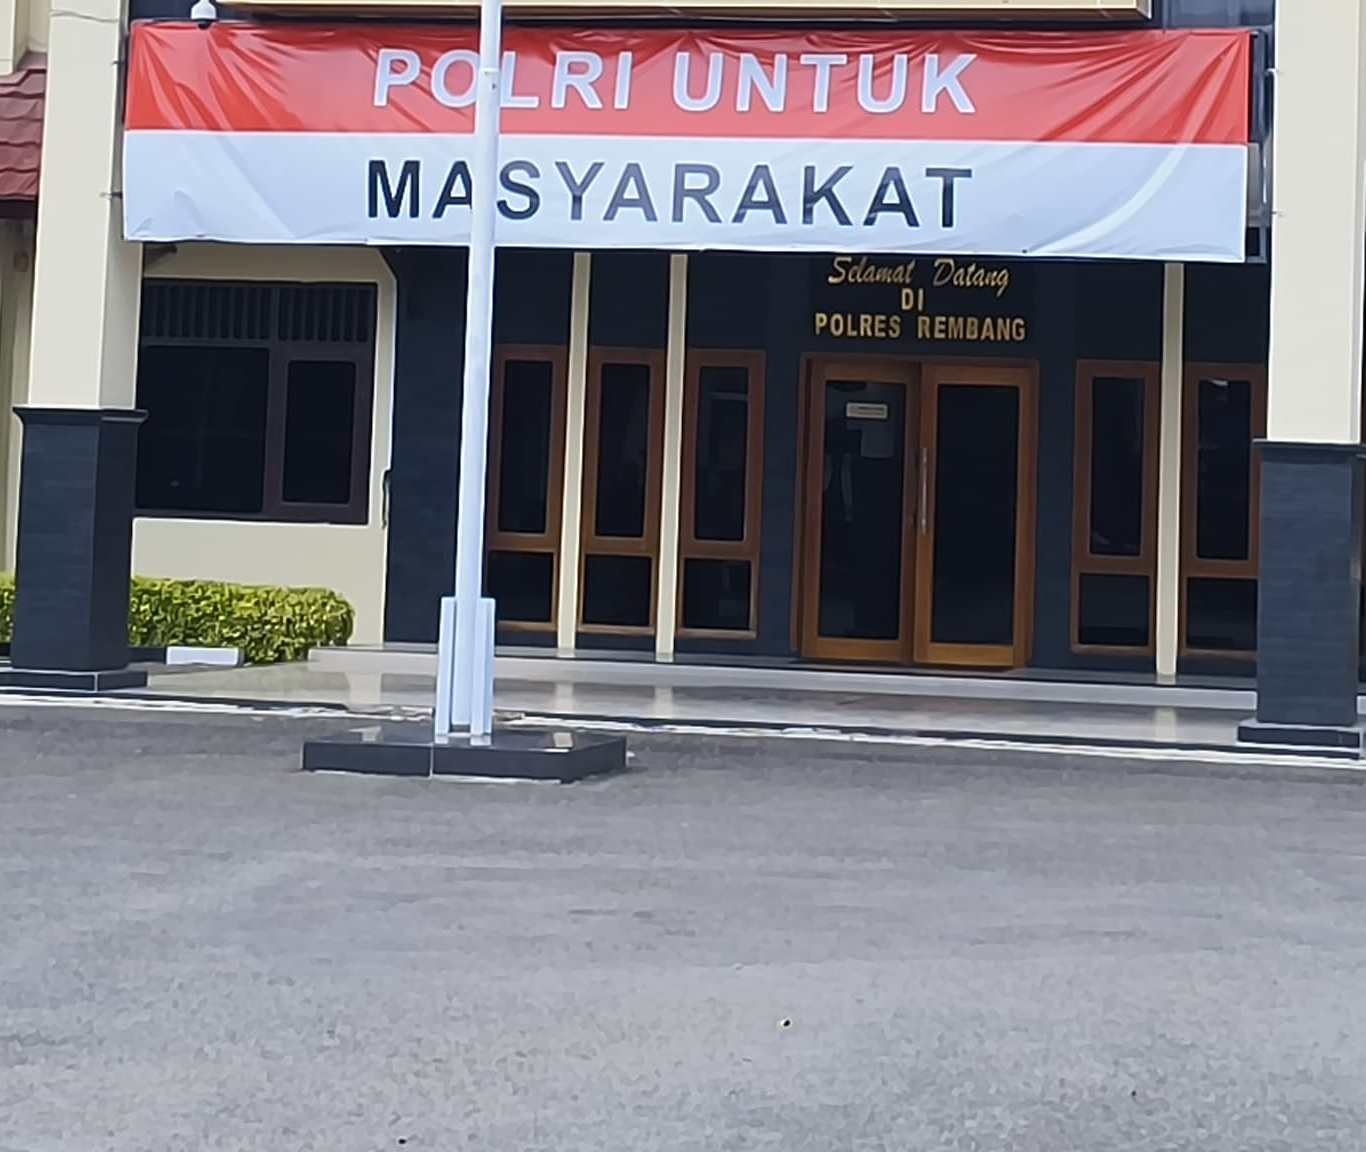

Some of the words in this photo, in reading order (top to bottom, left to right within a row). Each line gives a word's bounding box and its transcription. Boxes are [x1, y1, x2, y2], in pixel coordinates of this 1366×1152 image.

[372, 48, 631, 111] POLRI
[671, 51, 977, 115] UNTUK
[366, 159, 973, 229] MASYARAKAT
[827, 256, 916, 284] Selamat
[933, 258, 1010, 297] Datang
[901, 288, 925, 311] DI
[815, 313, 901, 338] POLRES
[917, 316, 1026, 341] REMBANG
